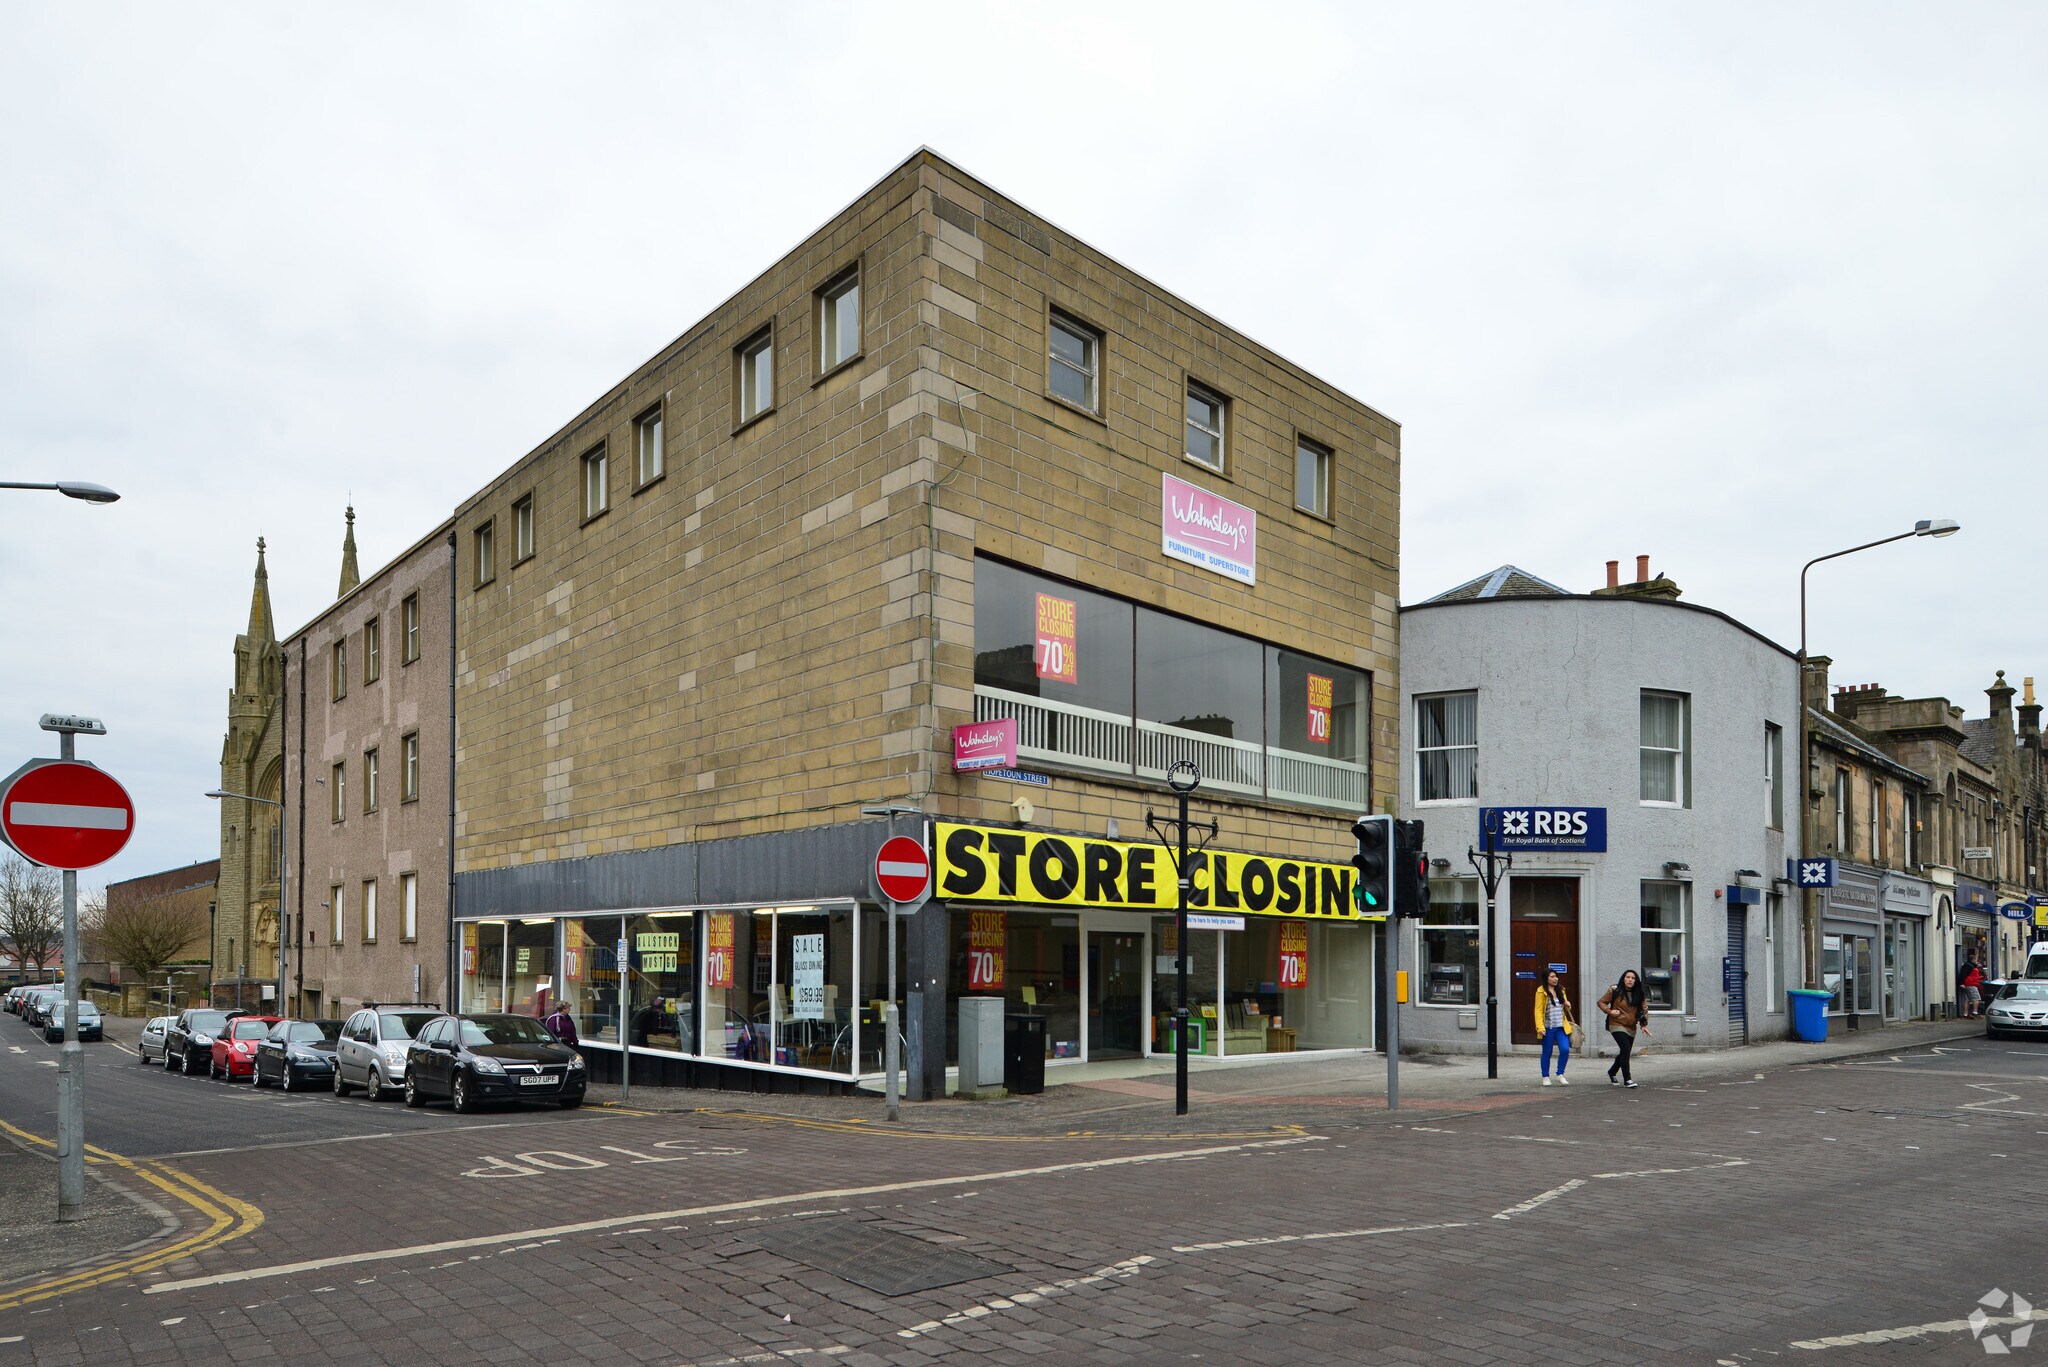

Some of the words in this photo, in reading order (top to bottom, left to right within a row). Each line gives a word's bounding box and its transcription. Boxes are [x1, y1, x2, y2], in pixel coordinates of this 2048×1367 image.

[1171, 492, 1248, 551] Walmsley's
[1168, 540, 1206, 561] FURNITURE
[1208, 555, 1250, 578] SUPERSTORE
[1039, 595, 1074, 623] STORE
[1039, 616, 1074, 639] CLOSING
[1063, 663, 1074, 677] OFF
[1309, 675, 1332, 696] STORE
[1309, 692, 1332, 709] CLOSING
[50, 717, 72, 727] 674
[79, 719, 93, 729] SB
[959, 729, 1004, 748] Walmsley's
[958, 760, 979, 769] FURNITURE
[1023, 772, 1047, 784] STREET
[1534, 810, 1588, 835] RBS
[1515, 837, 1534, 845] Royal
[1550, 837, 1558, 845] of
[943, 828, 1156, 904] STORE
[1187, 851, 1358, 917] CLOSIN
[710, 914, 732, 932] STORE
[972, 912, 1004, 932] STORE
[1281, 922, 1307, 939] STORE
[710, 932, 732, 947] CLOSING
[795, 937, 822, 953] SALE
[972, 932, 1004, 947] CLOSING
[1281, 938, 1307, 952] CLOSING
[643, 956, 663, 969] MUST
[666, 956, 676, 969] GO
[994, 972, 1003, 982] OFF
[523, 1076, 541, 1084] SG07
[542, 1075, 556, 1083] UPF
